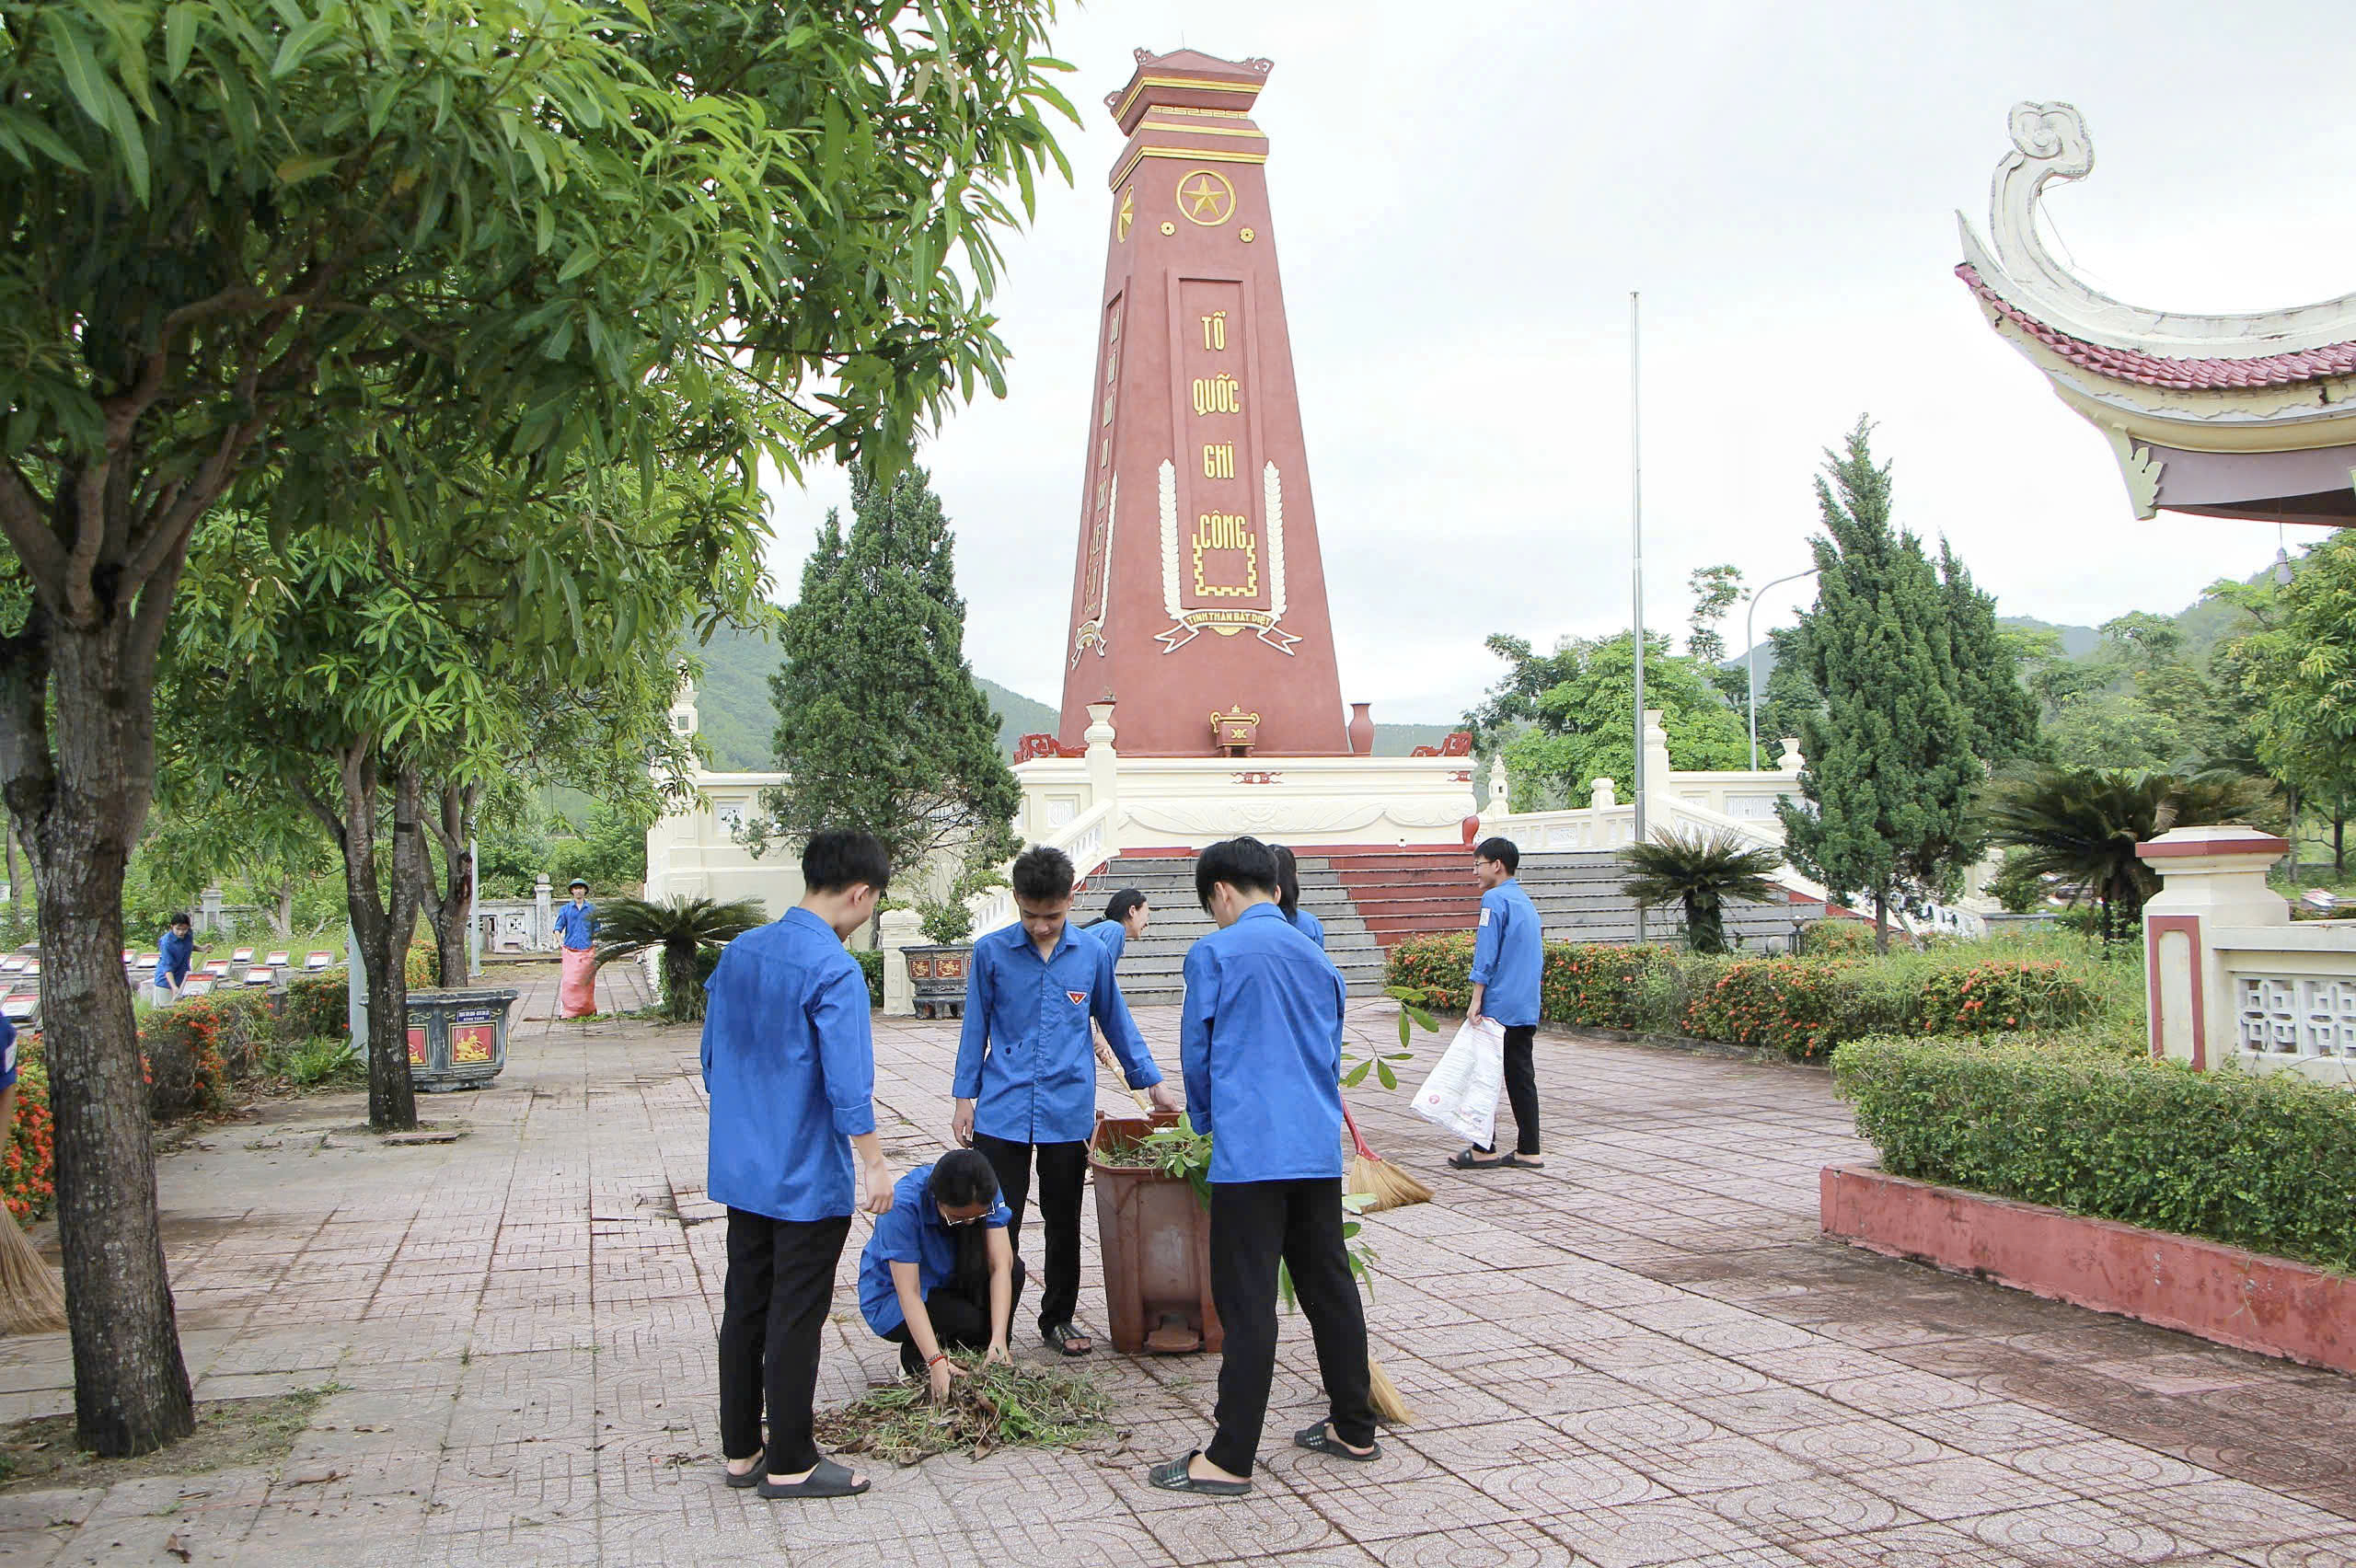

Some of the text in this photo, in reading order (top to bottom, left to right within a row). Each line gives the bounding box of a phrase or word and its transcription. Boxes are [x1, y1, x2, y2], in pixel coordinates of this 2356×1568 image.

[1192, 373, 1241, 417] QUỐC
[1203, 440, 1235, 478] GHI
[1199, 509, 1248, 549] CÔNG
[1187, 612, 1207, 624] TINH
